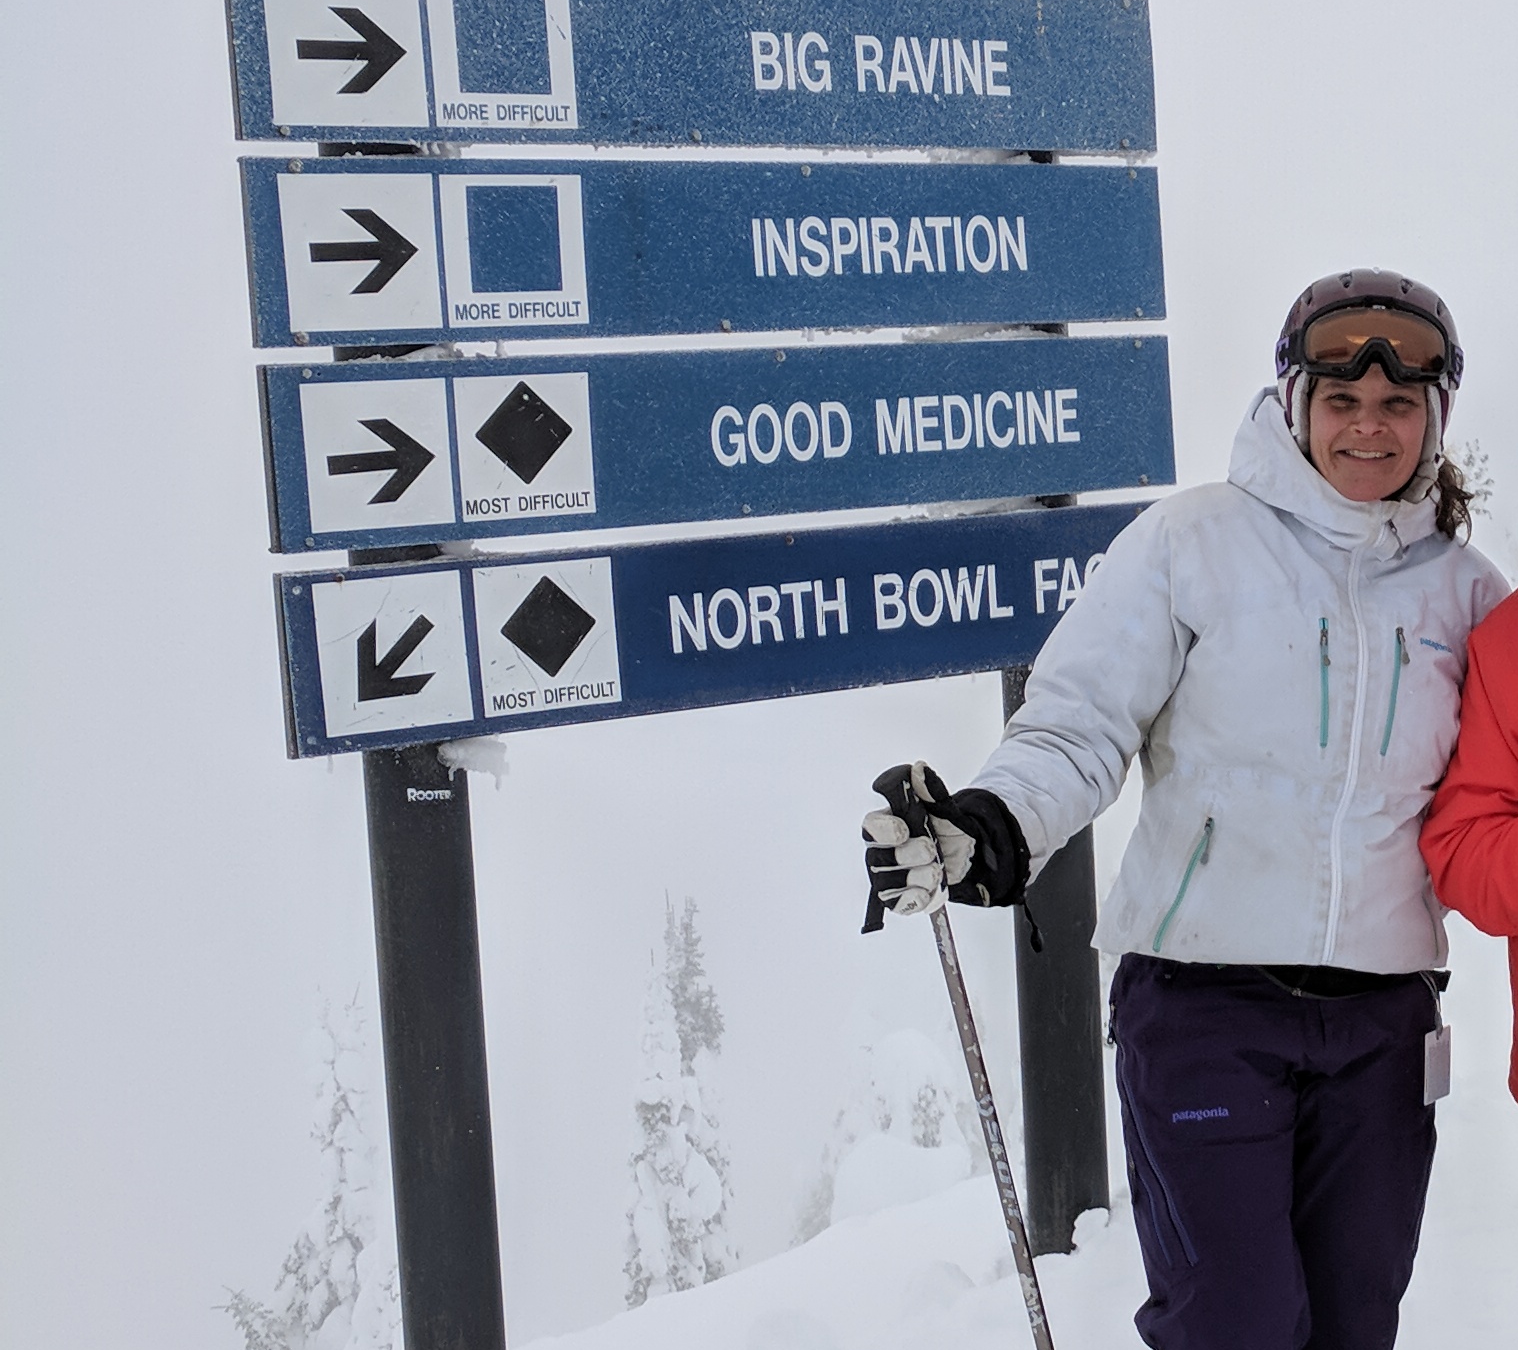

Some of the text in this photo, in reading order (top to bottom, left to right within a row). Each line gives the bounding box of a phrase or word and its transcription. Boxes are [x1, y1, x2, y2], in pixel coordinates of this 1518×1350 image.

[751, 31, 1011, 96] BIG RAVINE
[442, 103, 570, 122] MORE DIFFICULT
[751, 214, 1028, 277] INSPIRATION
[455, 301, 581, 320] MORE DIFFICULT
[710, 389, 1081, 467] GOOD MEDICINE
[466, 491, 590, 515] MOST DIFFICULT
[668, 577, 848, 654] NORTH
[873, 564, 1014, 630] BOWL
[492, 681, 615, 711] MOST DIFFICULT
[1172, 1107, 1229, 1123] patagonia
